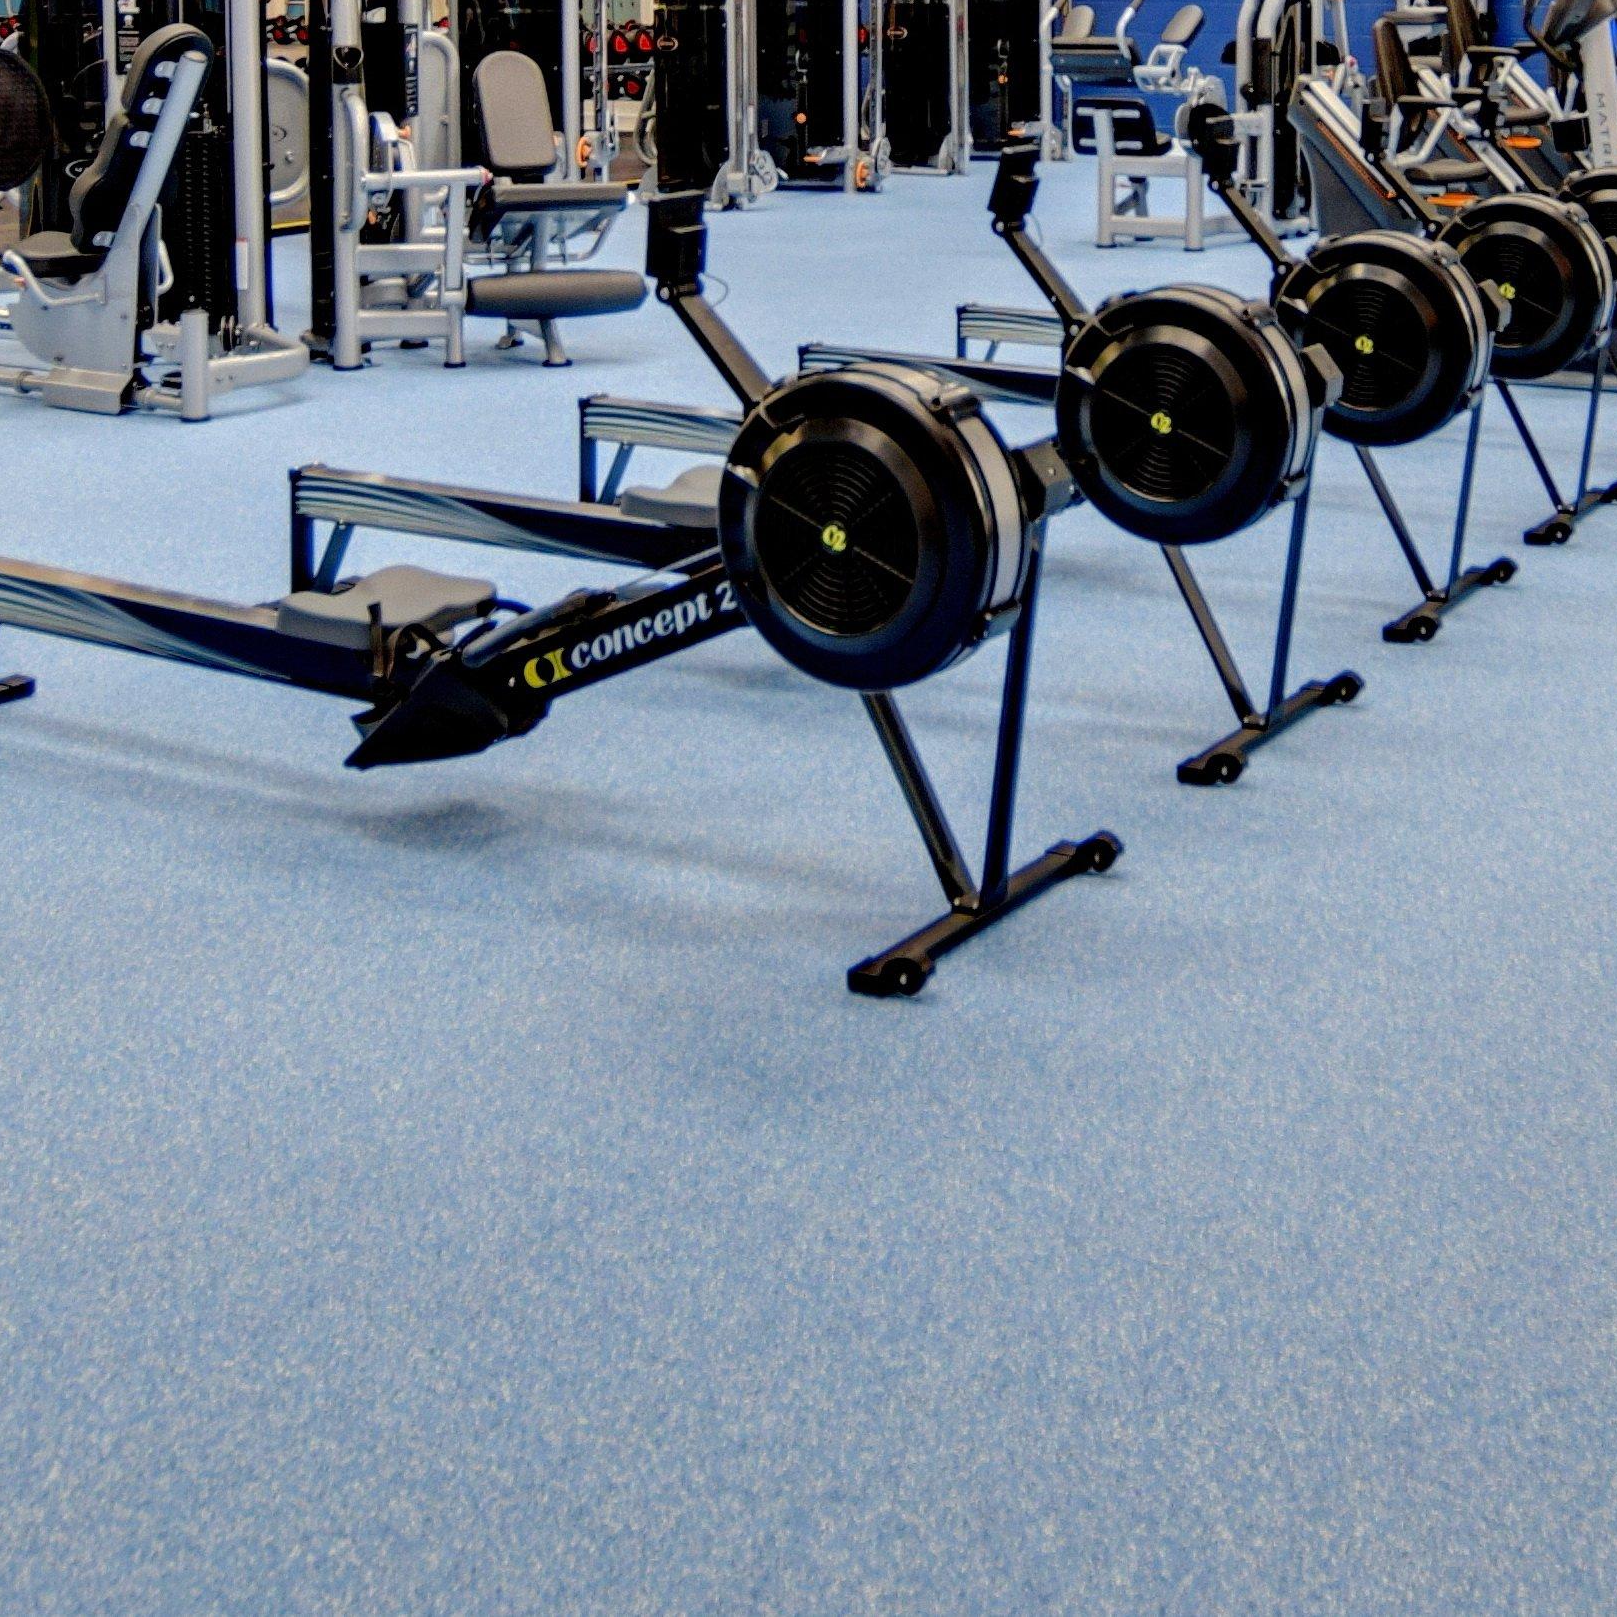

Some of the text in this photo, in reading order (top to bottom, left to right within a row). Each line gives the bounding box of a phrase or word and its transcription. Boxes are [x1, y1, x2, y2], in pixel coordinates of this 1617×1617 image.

[1596, 92, 1614, 166] MATRI
[570, 592, 713, 670] concept
[715, 580, 738, 612] 2
